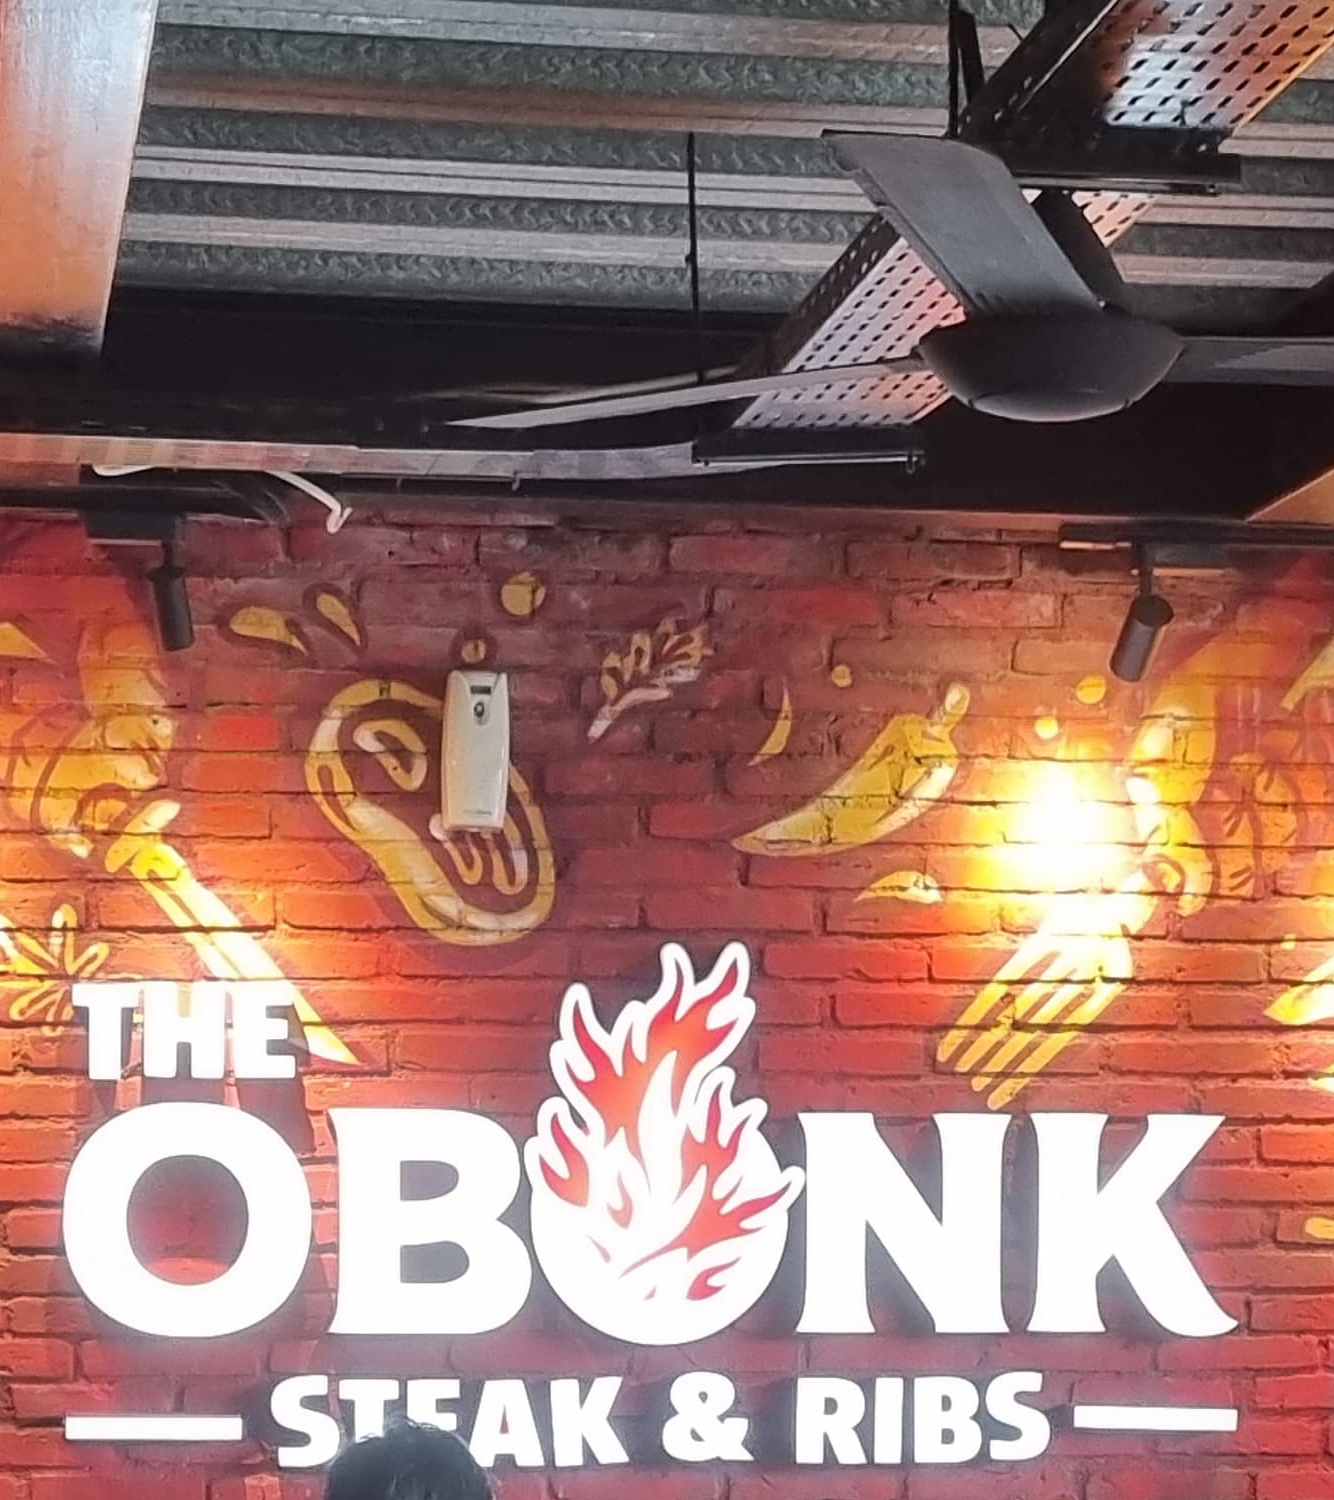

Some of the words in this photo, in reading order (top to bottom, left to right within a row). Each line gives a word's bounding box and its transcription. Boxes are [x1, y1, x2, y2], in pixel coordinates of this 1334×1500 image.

[71, 983, 298, 1081] THE
[270, 1374, 630, 1468] STEAK
[662, 1370, 754, 1463] &
[796, 1371, 1051, 1465] RIBS
